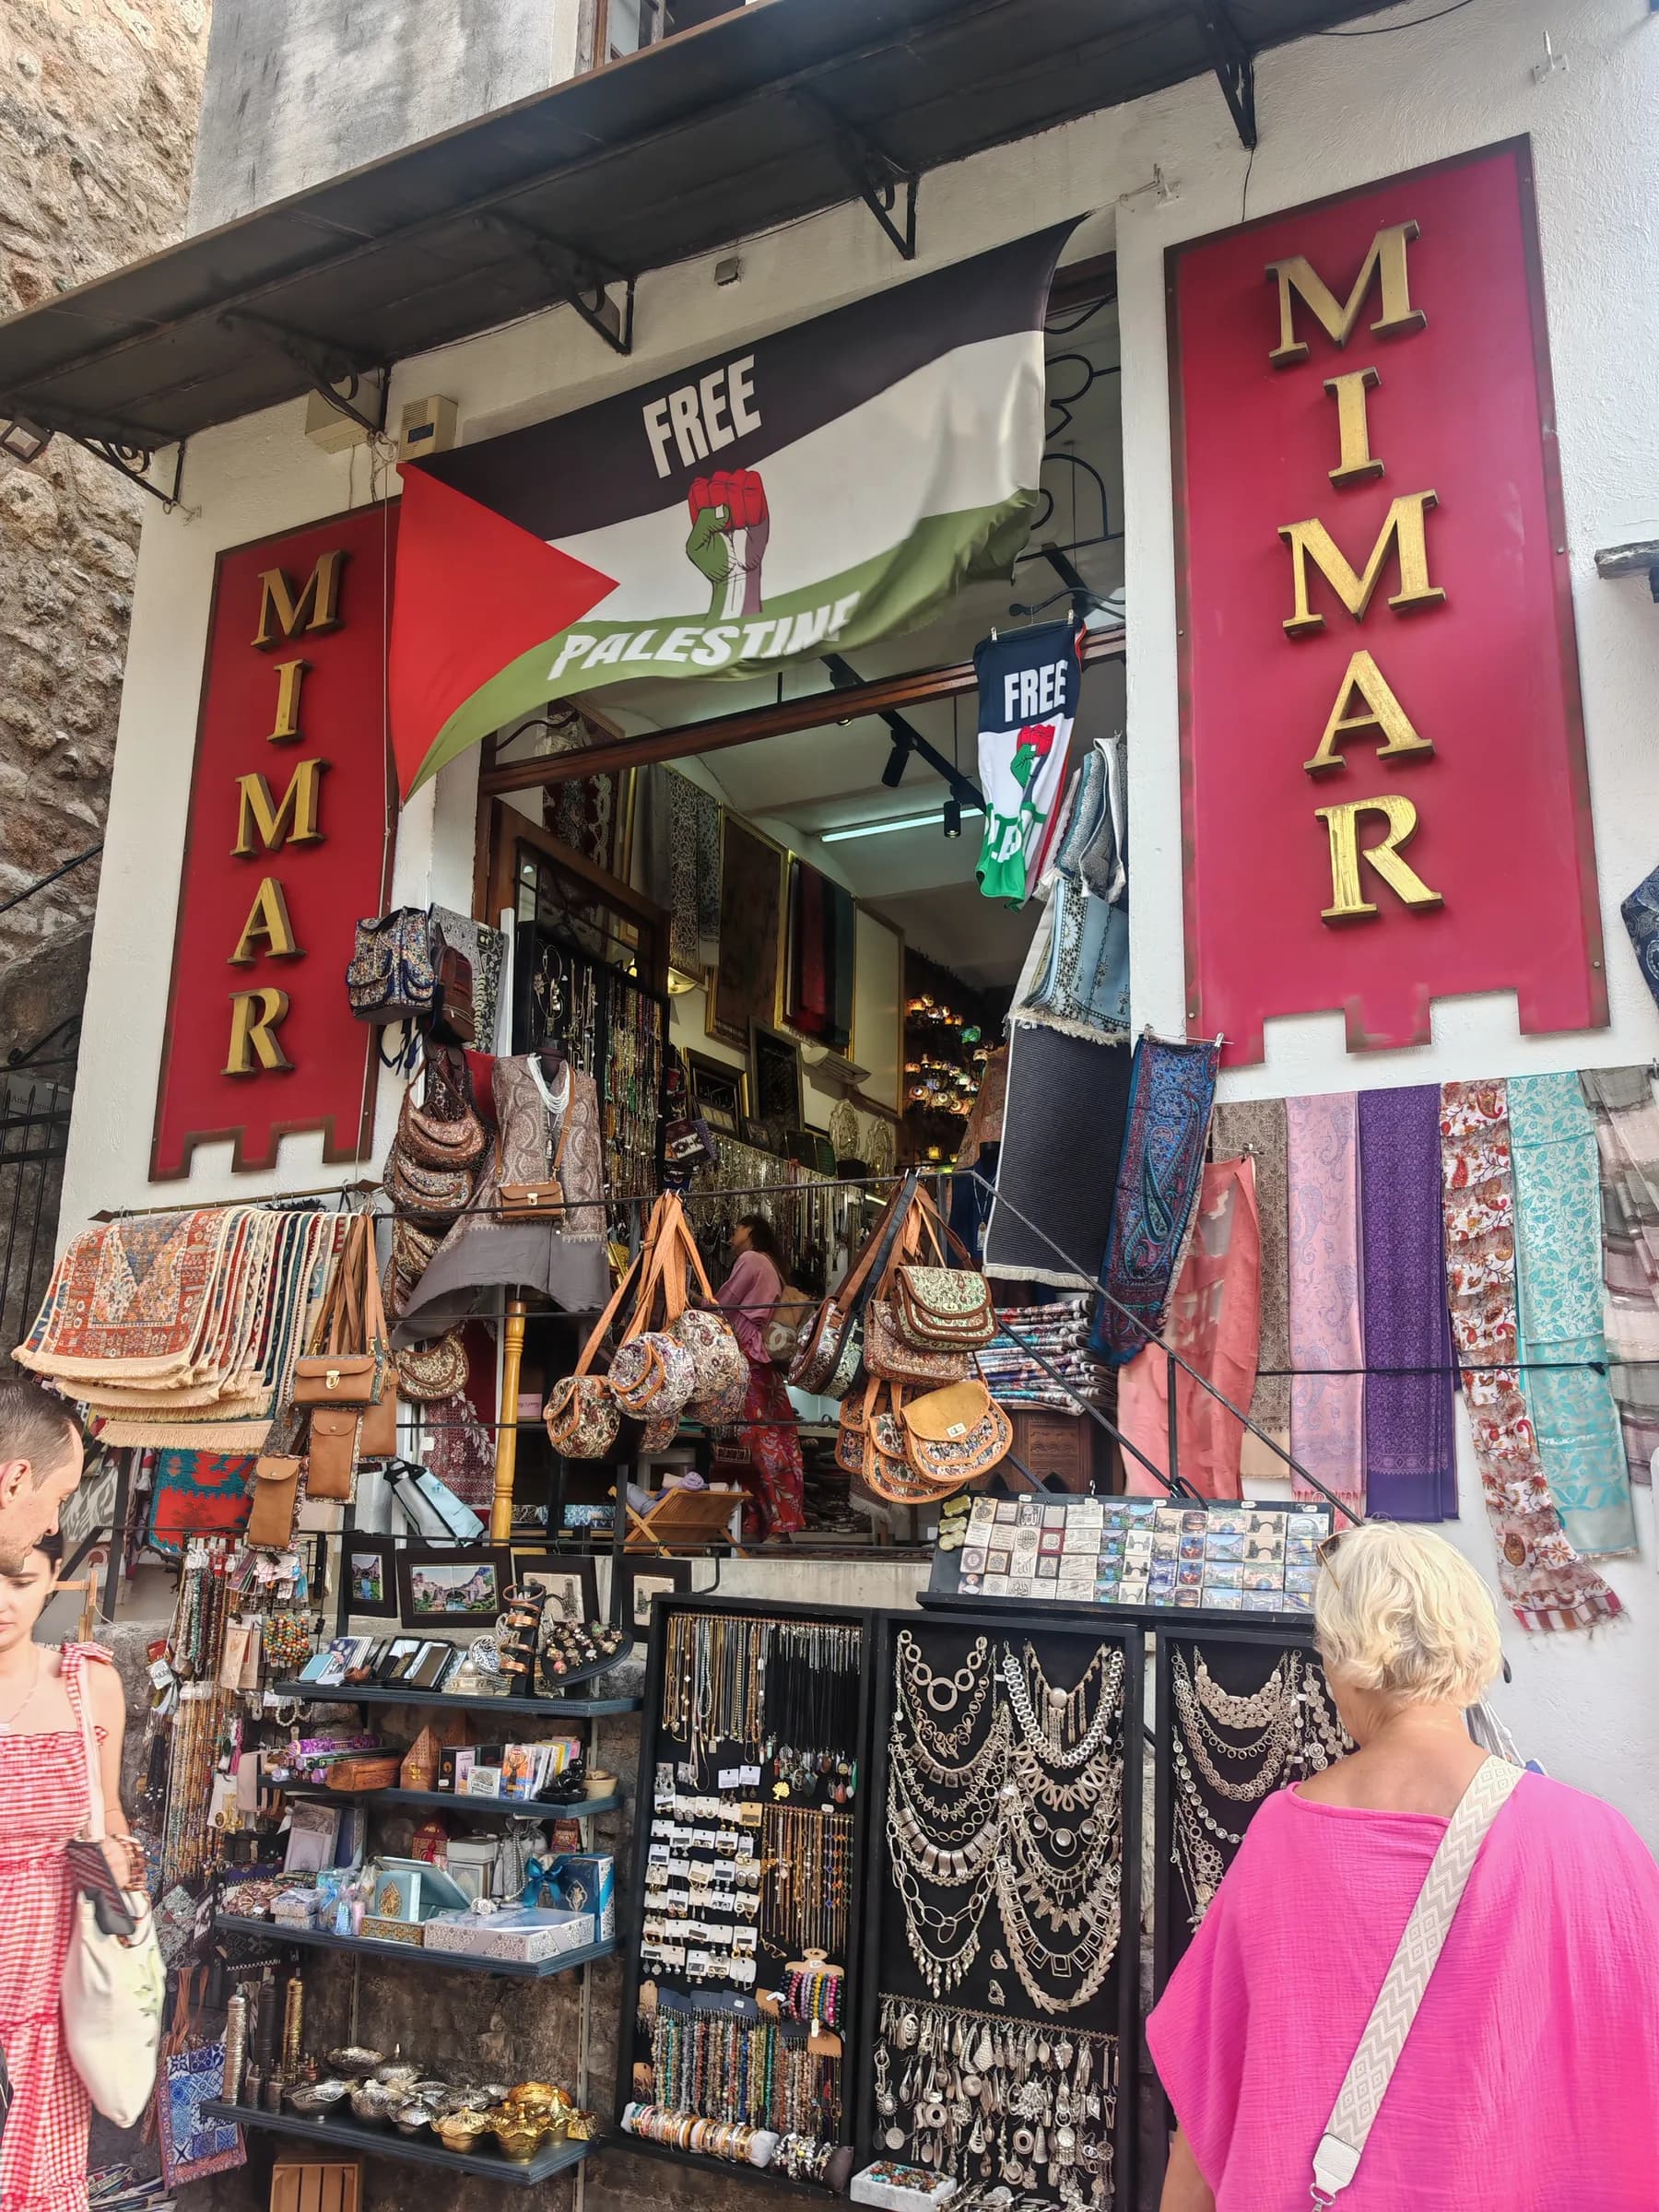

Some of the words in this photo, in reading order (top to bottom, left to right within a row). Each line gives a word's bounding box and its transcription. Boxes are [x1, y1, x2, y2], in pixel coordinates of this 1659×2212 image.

[642, 354, 761, 478] FREE
[1265, 218, 1445, 924] MIMAR
[220, 549, 345, 1077] MIMAR
[1005, 659, 1068, 723] FREE
